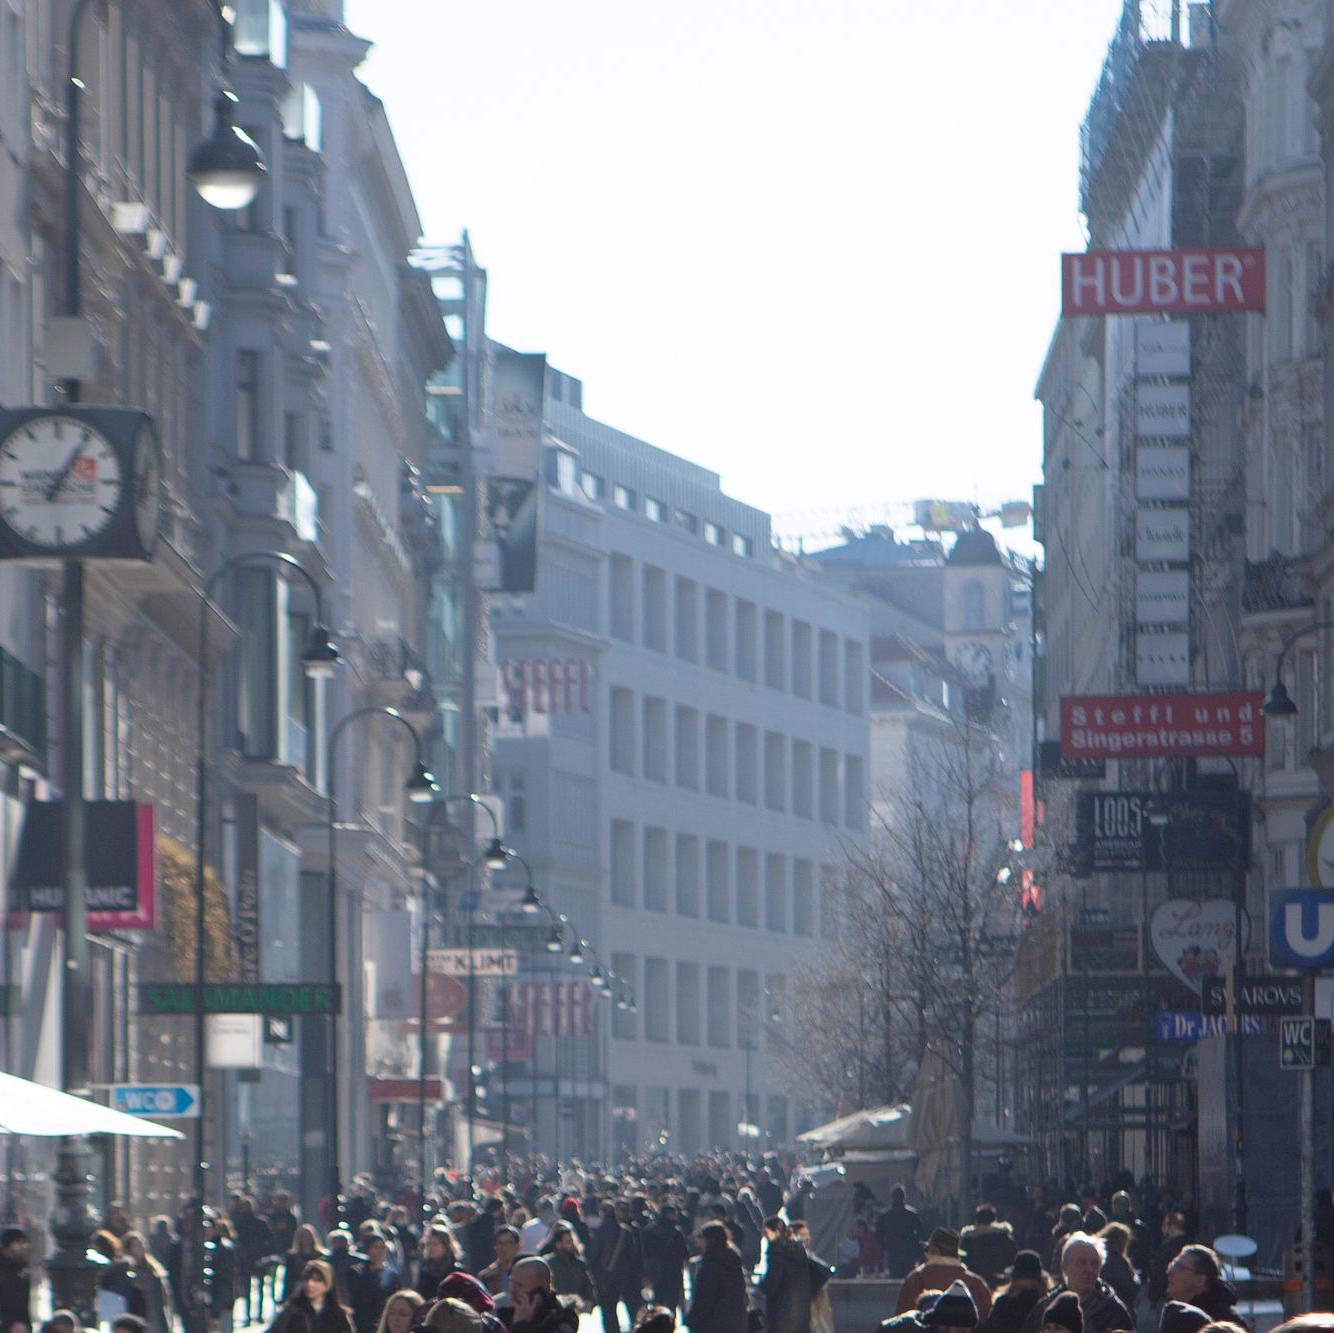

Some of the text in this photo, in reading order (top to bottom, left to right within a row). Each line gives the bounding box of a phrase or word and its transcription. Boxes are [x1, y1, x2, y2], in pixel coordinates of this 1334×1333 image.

[1072, 253, 1244, 307] HUBER
[1071, 703, 1253, 726] Steffl und
[1071, 725, 1254, 752] Singerstrasse 5
[1094, 797, 1141, 838] LOOS
[1285, 903, 1334, 957] U
[454, 954, 516, 970] KLIMT
[149, 985, 335, 1012] SALMANDER
[1175, 1013, 1195, 1037] Dr
[1283, 1022, 1310, 1046] WC
